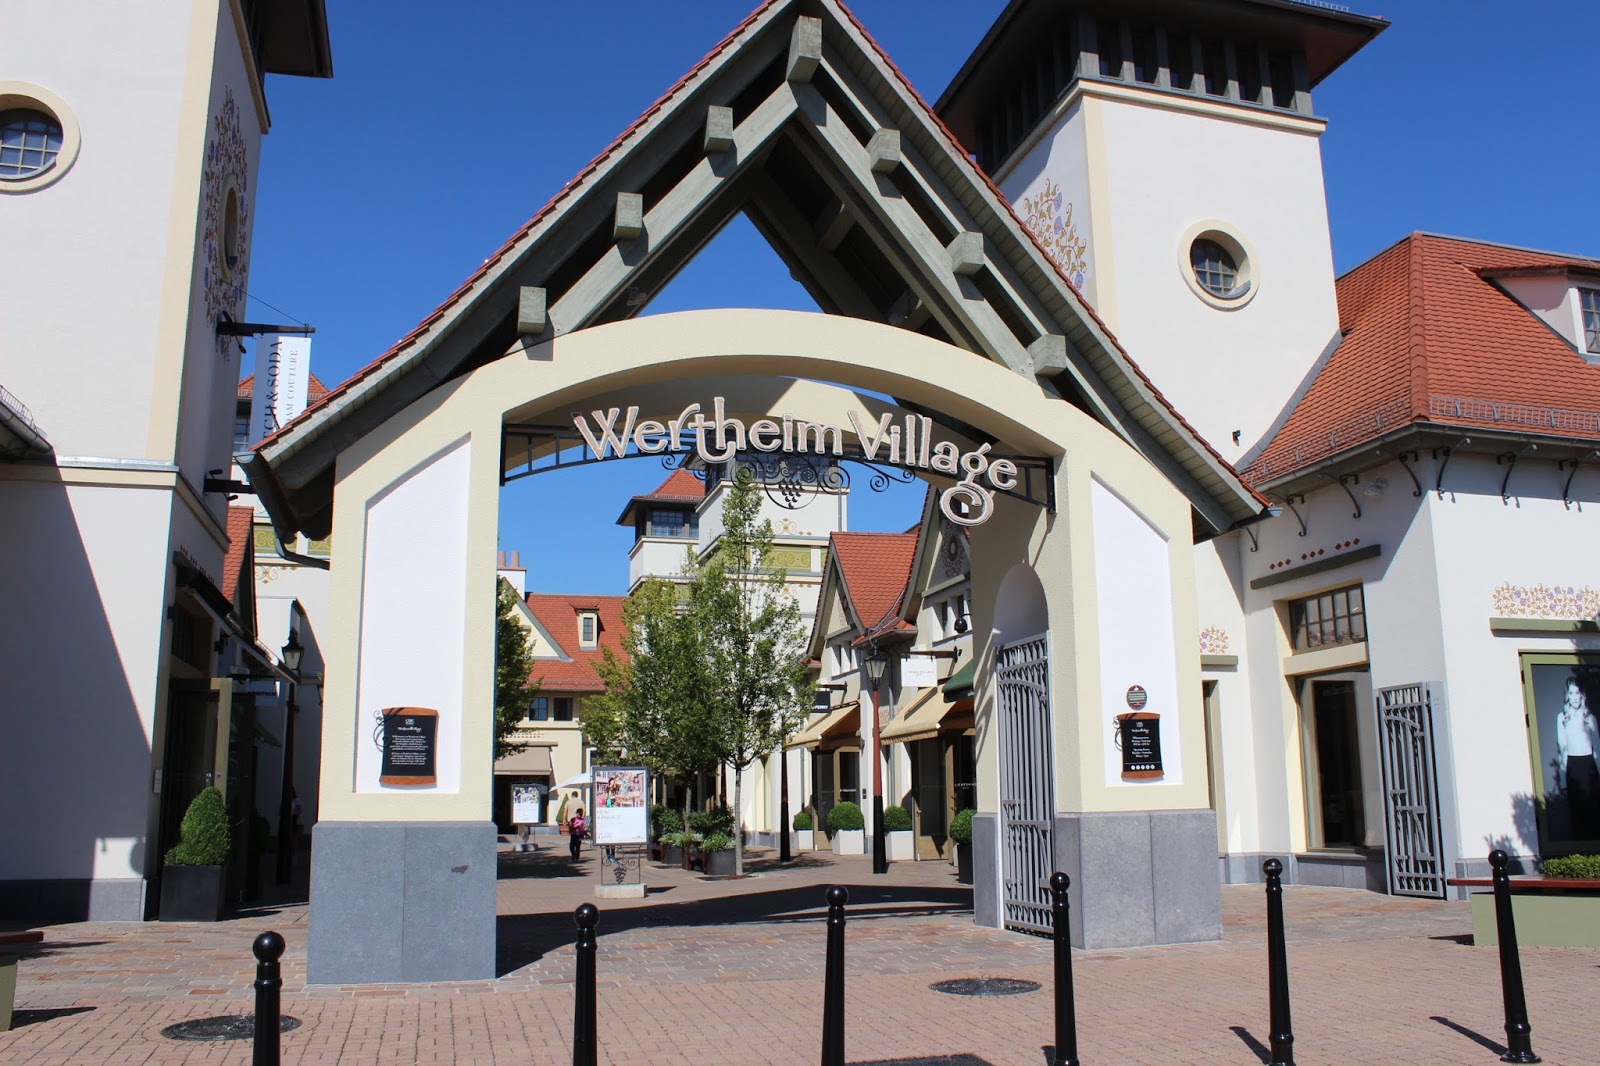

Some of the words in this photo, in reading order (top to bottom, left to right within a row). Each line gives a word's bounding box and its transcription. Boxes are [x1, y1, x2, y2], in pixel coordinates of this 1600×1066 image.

[268, 341, 282, 387] SODA
[287, 350, 297, 399] COUTURE
[572, 396, 843, 464] Wertheim
[847, 409, 1019, 526] Village
